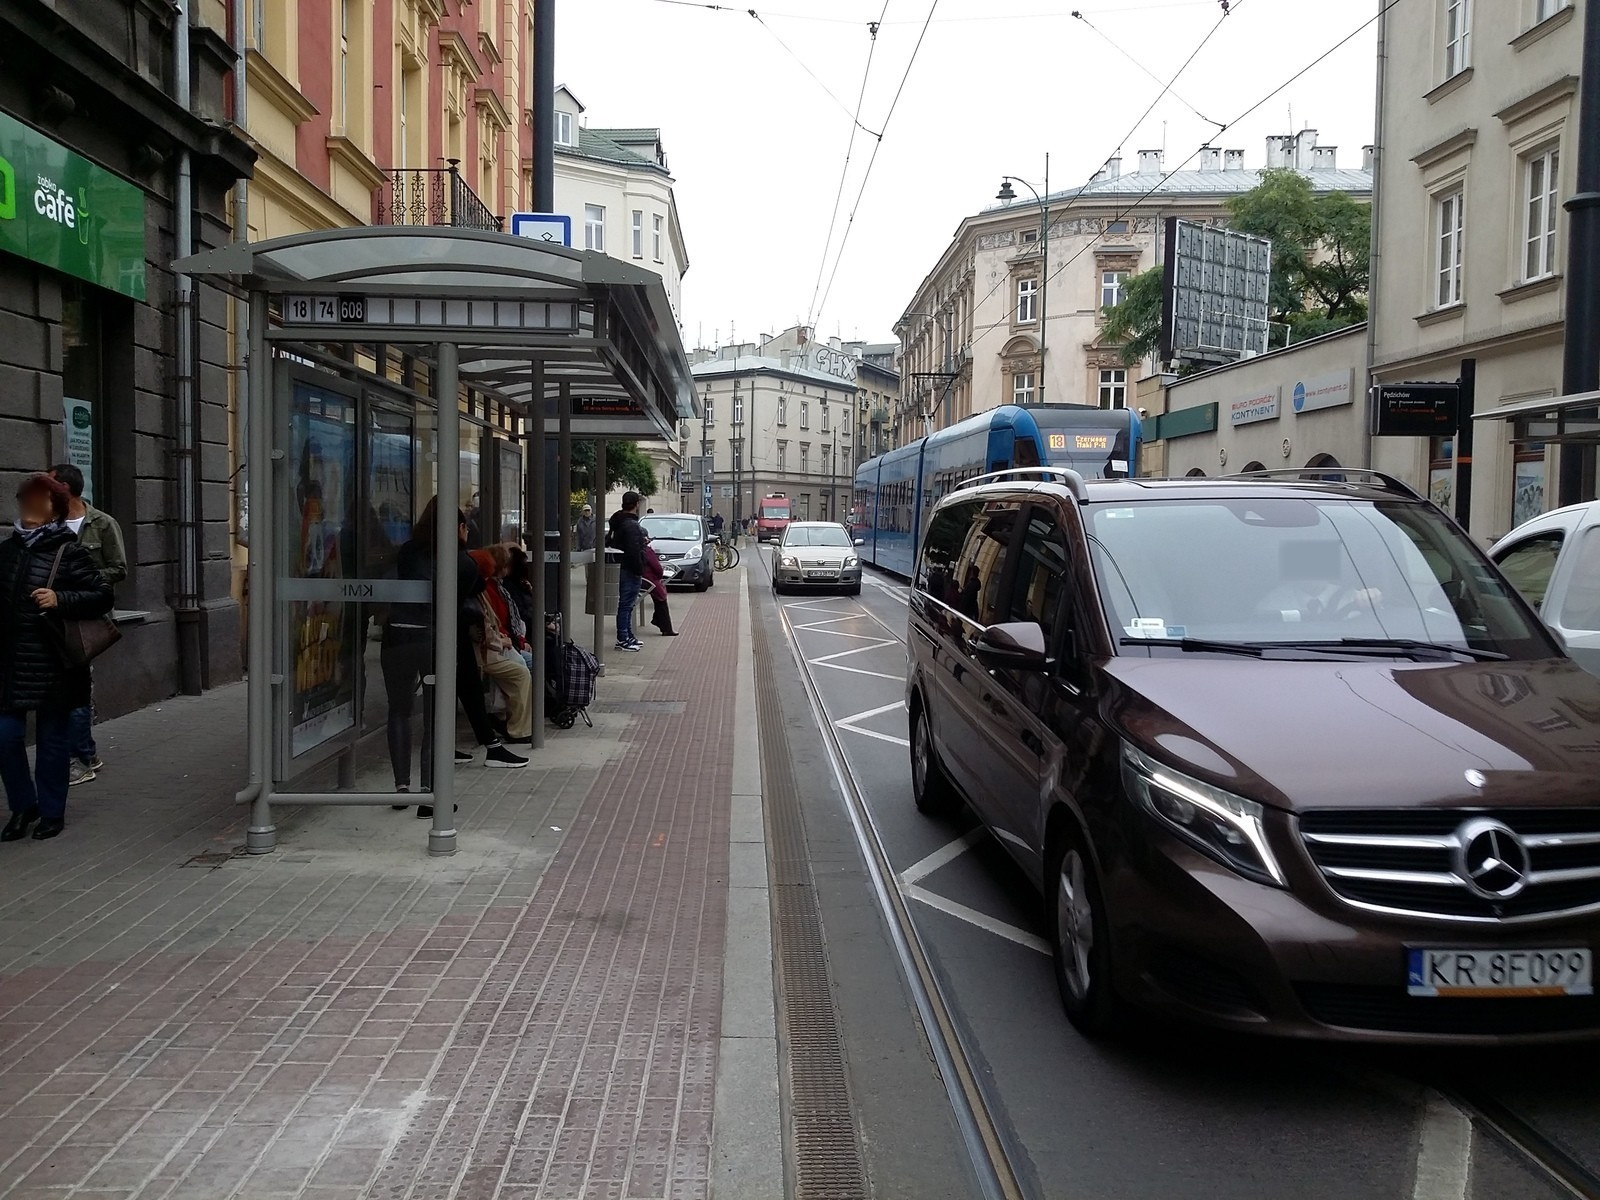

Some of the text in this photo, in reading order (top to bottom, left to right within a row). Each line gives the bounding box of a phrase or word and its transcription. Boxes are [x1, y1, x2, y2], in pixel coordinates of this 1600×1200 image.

[293, 301, 363, 319] 18 74 608
[816, 348, 857, 381] SHX
[1231, 394, 1276, 410] BIURO PODRÓŻY
[1231, 404, 1276, 420] KONTYNENT
[1050, 435, 1064, 447] 18
[1430, 952, 1584, 985] KR 8F099
